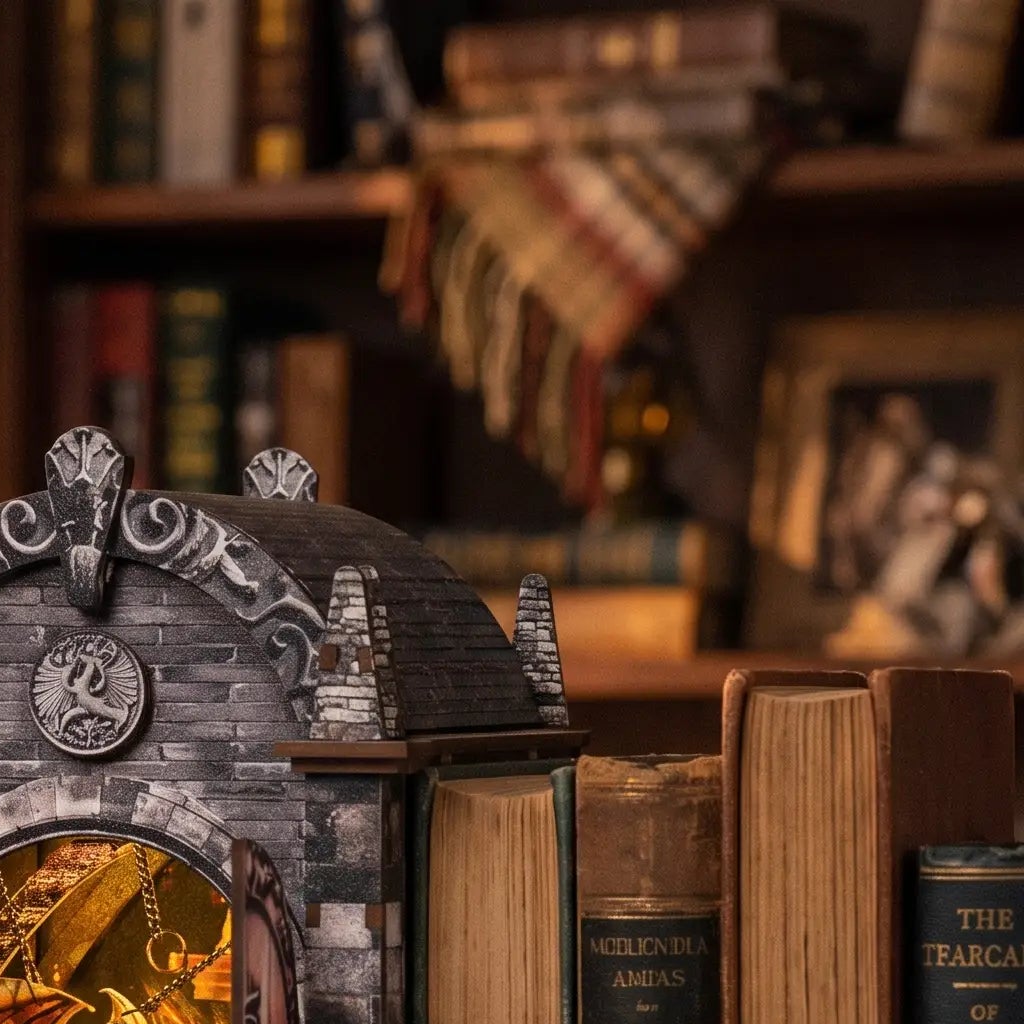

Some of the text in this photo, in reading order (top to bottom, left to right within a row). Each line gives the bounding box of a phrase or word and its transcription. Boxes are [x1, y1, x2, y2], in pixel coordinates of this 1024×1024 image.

[957, 908, 1014, 930] THE
[921, 942, 1024, 969] TFARCA
[969, 1004, 1000, 1022] OF
